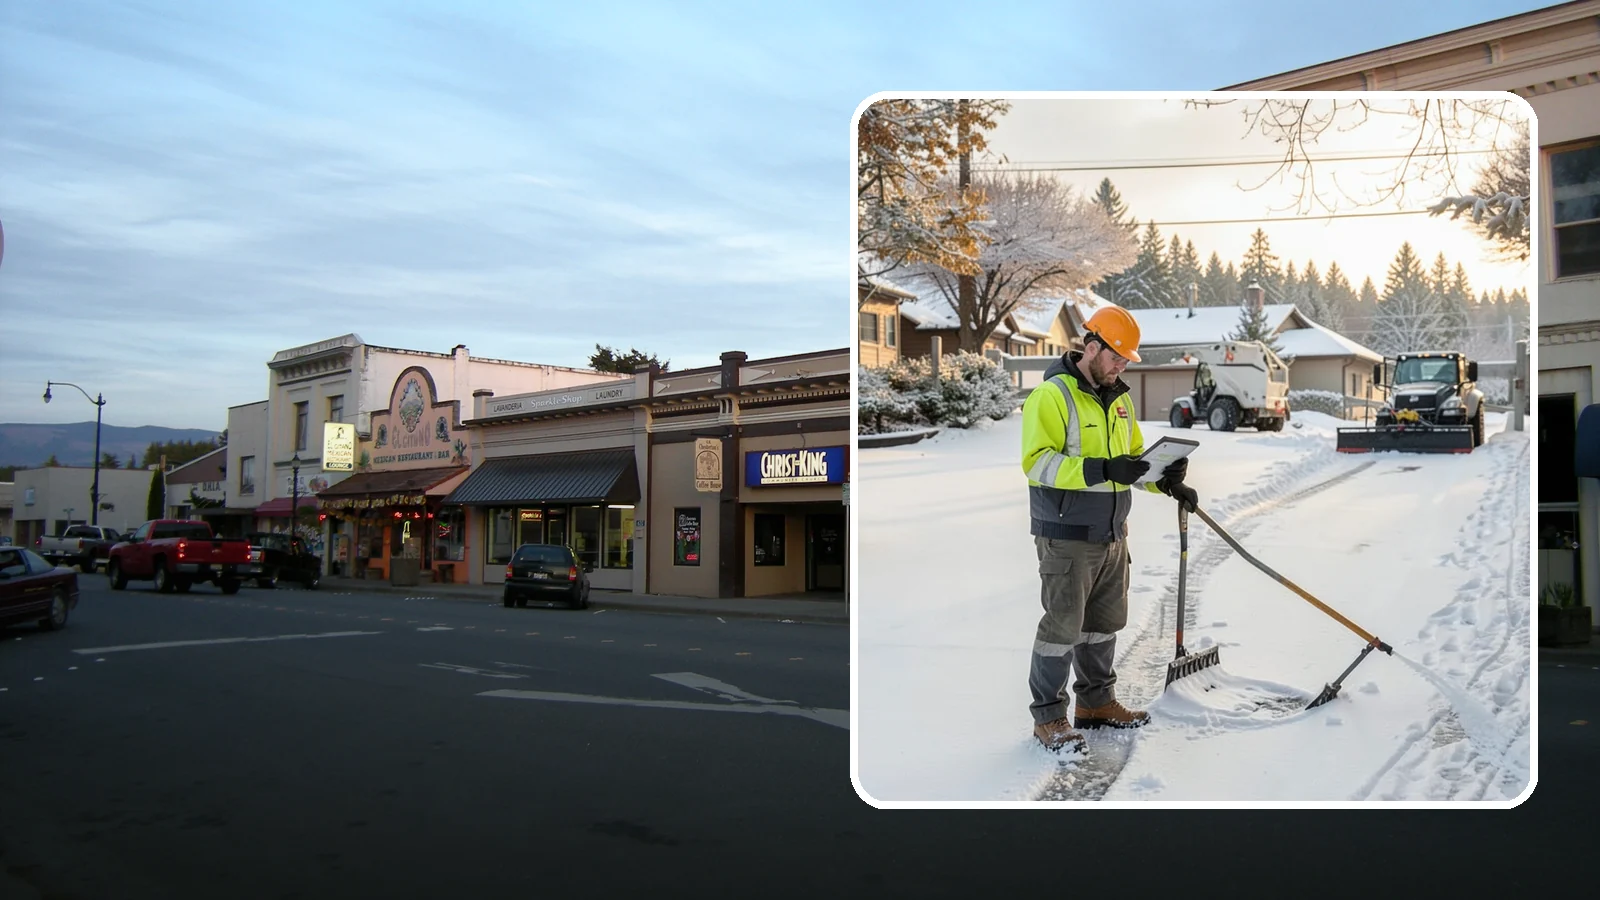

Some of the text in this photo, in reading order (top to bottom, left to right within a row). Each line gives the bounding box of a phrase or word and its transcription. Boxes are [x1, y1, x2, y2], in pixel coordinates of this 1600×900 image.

[561, 394, 582, 405] Shop
[595, 389, 623, 399] LAUNDRY
[493, 402, 523, 413] LAVANDERIA
[397, 451, 434, 462] RESTAURANT
[438, 450, 450, 459] BAR
[761, 451, 797, 477] CHRIST
[799, 449, 827, 476] KING
